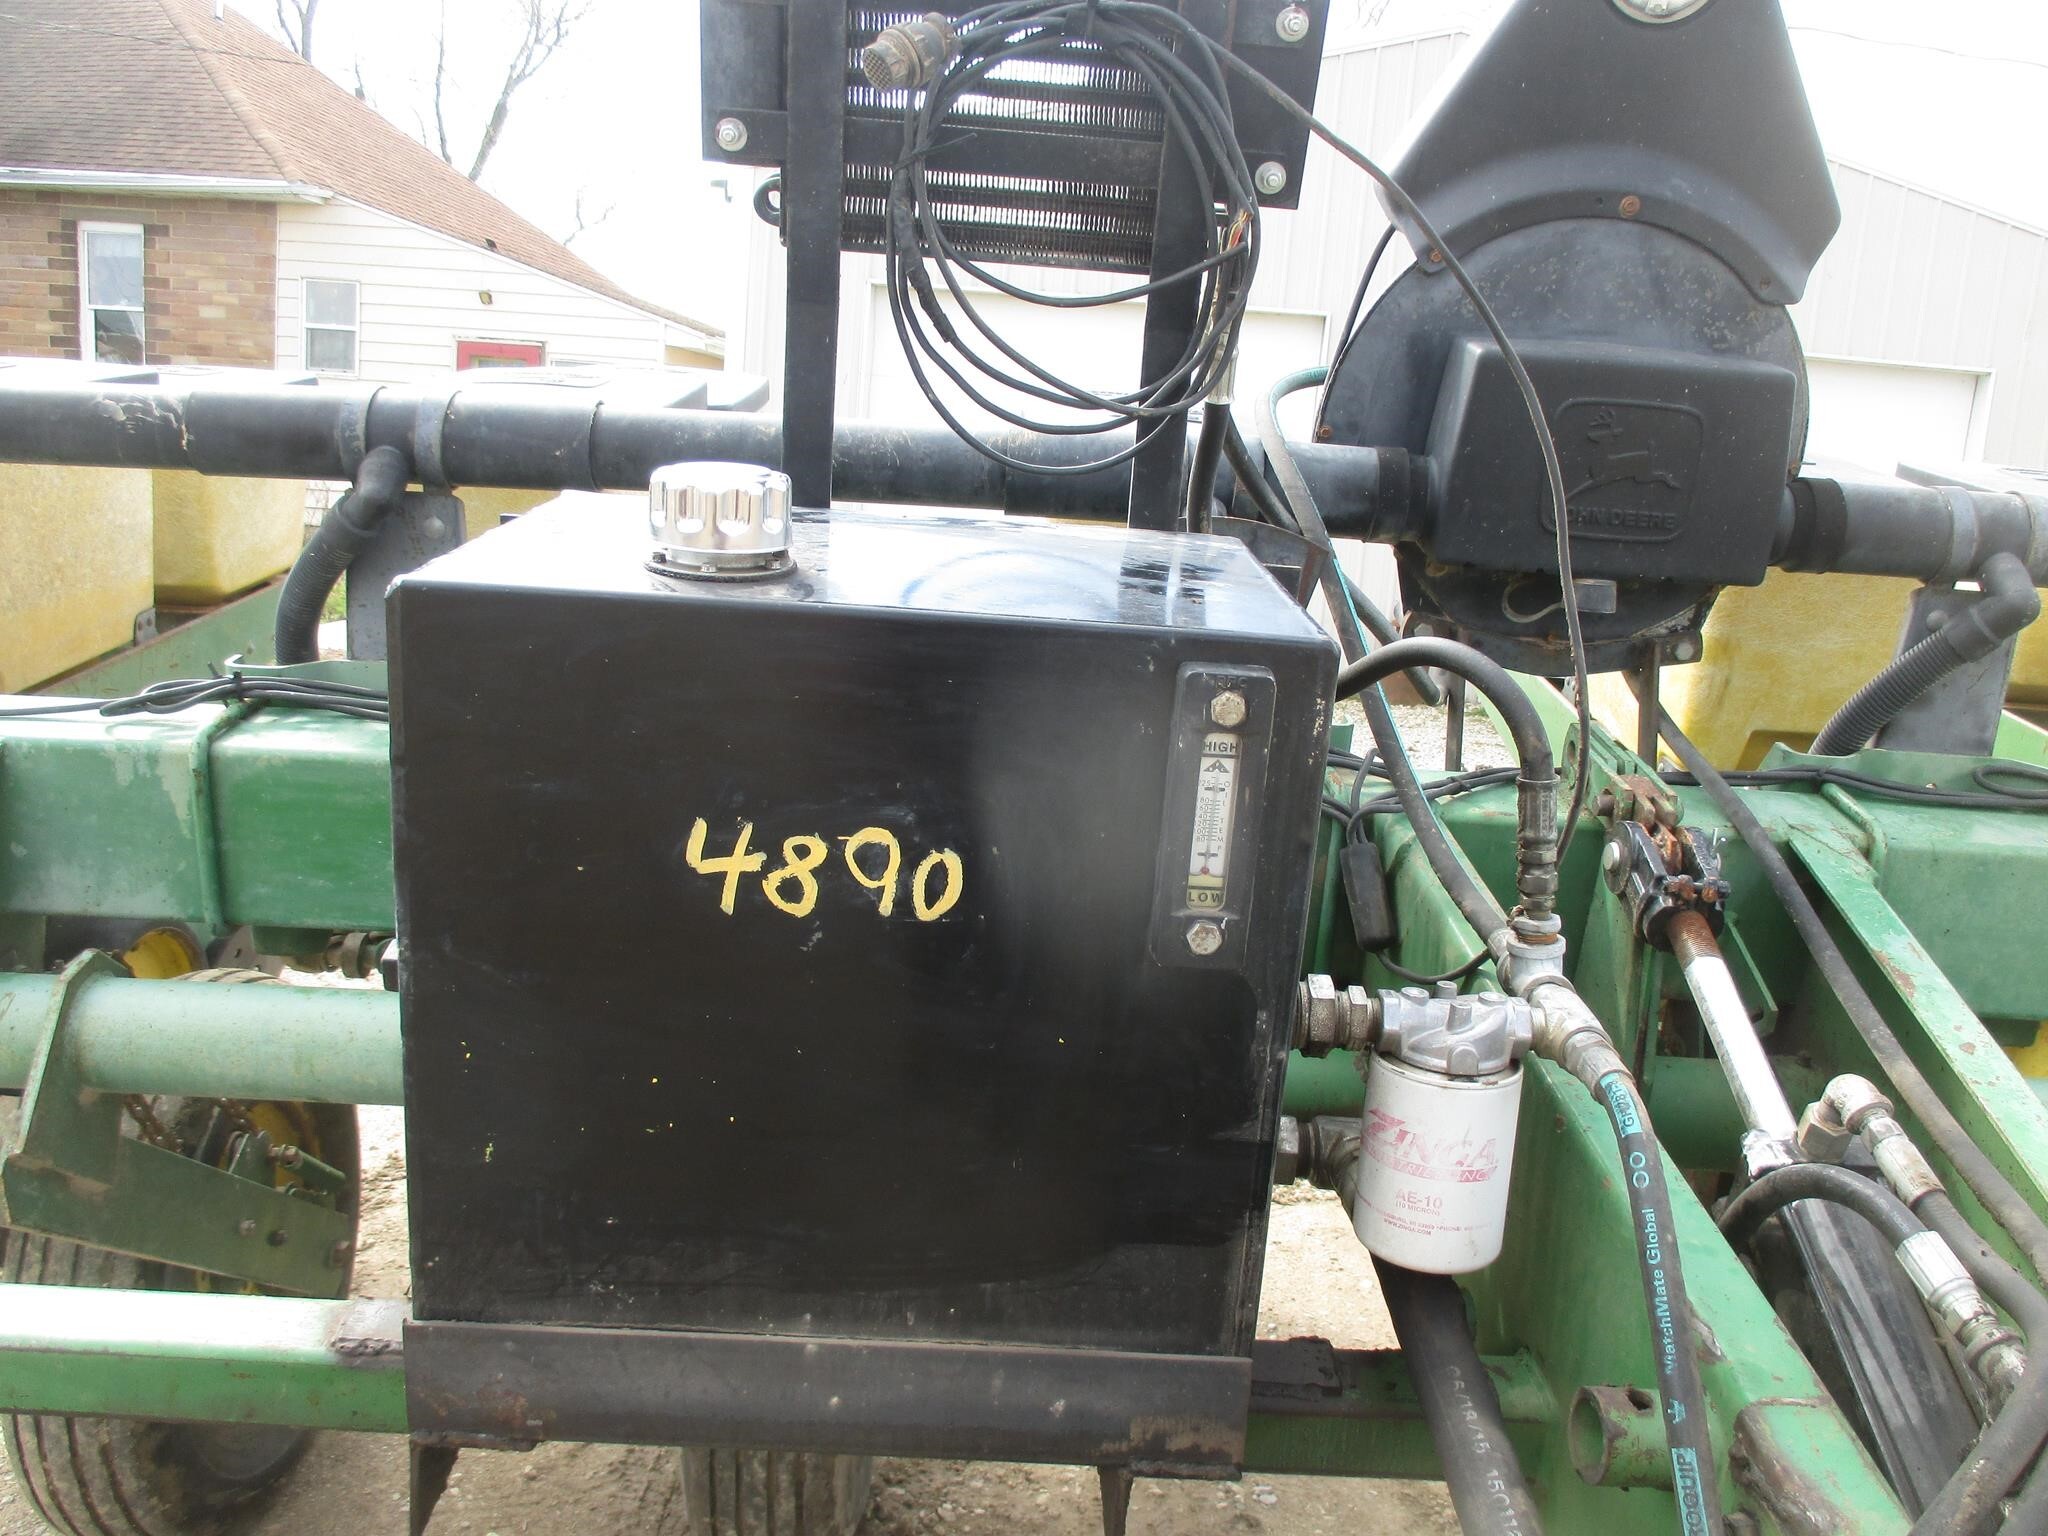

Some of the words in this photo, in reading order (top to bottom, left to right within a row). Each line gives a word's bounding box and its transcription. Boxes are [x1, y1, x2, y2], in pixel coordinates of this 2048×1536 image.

[1567, 505, 1606, 525] OHN
[1610, 508, 1679, 529] DEERE
[1204, 741, 1238, 753] HIGH
[686, 817, 963, 921] 4890
[1188, 891, 1224, 903] LOW
[1395, 1188, 1443, 1210] AE-10
[1641, 1208, 1661, 1265] Global
